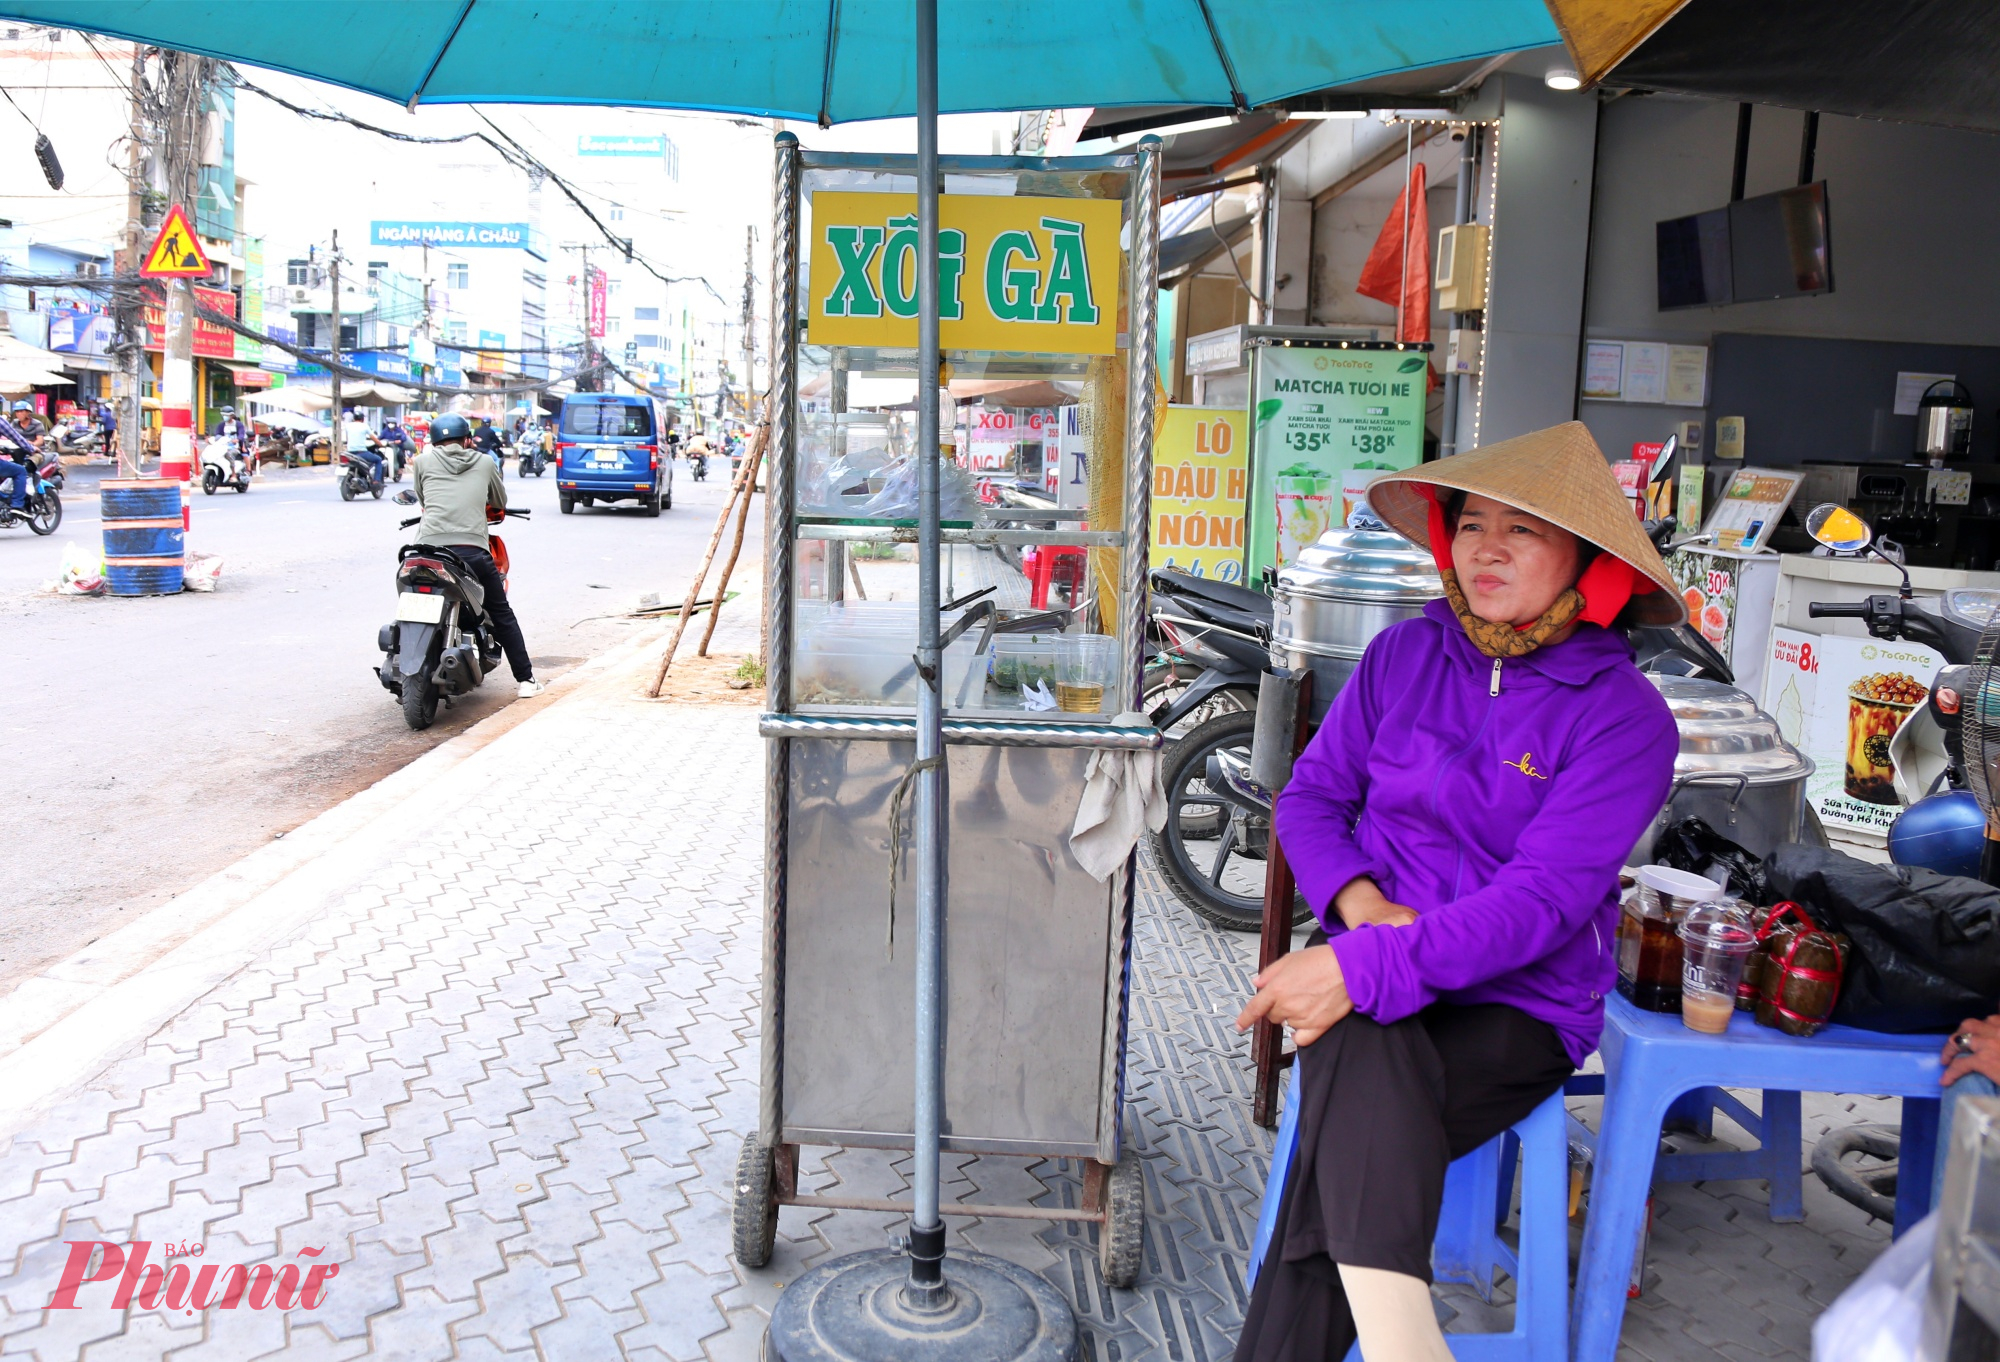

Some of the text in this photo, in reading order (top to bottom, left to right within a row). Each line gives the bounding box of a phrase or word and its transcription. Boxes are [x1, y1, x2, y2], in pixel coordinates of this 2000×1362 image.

[378, 225, 520, 243] NGÂN HÀNG Á CHÂU
[985, 216, 1100, 324] GÀ
[1275, 379, 1344, 395] MATCHA
[979, 409, 1014, 429] XÔI
[1196, 418, 1232, 455] LÒ
[1153, 461, 1217, 503] ĐẬU
[1708, 572, 1729, 595] 30K
[1775, 649, 1785, 660] ƯU
[1786, 651, 1798, 664] ĐÃI
[1820, 807, 1854, 822] Đường
[1823, 798, 1841, 808] Sữa
[1845, 802, 1867, 813] Tươi
[1870, 806, 1892, 818] Trân
